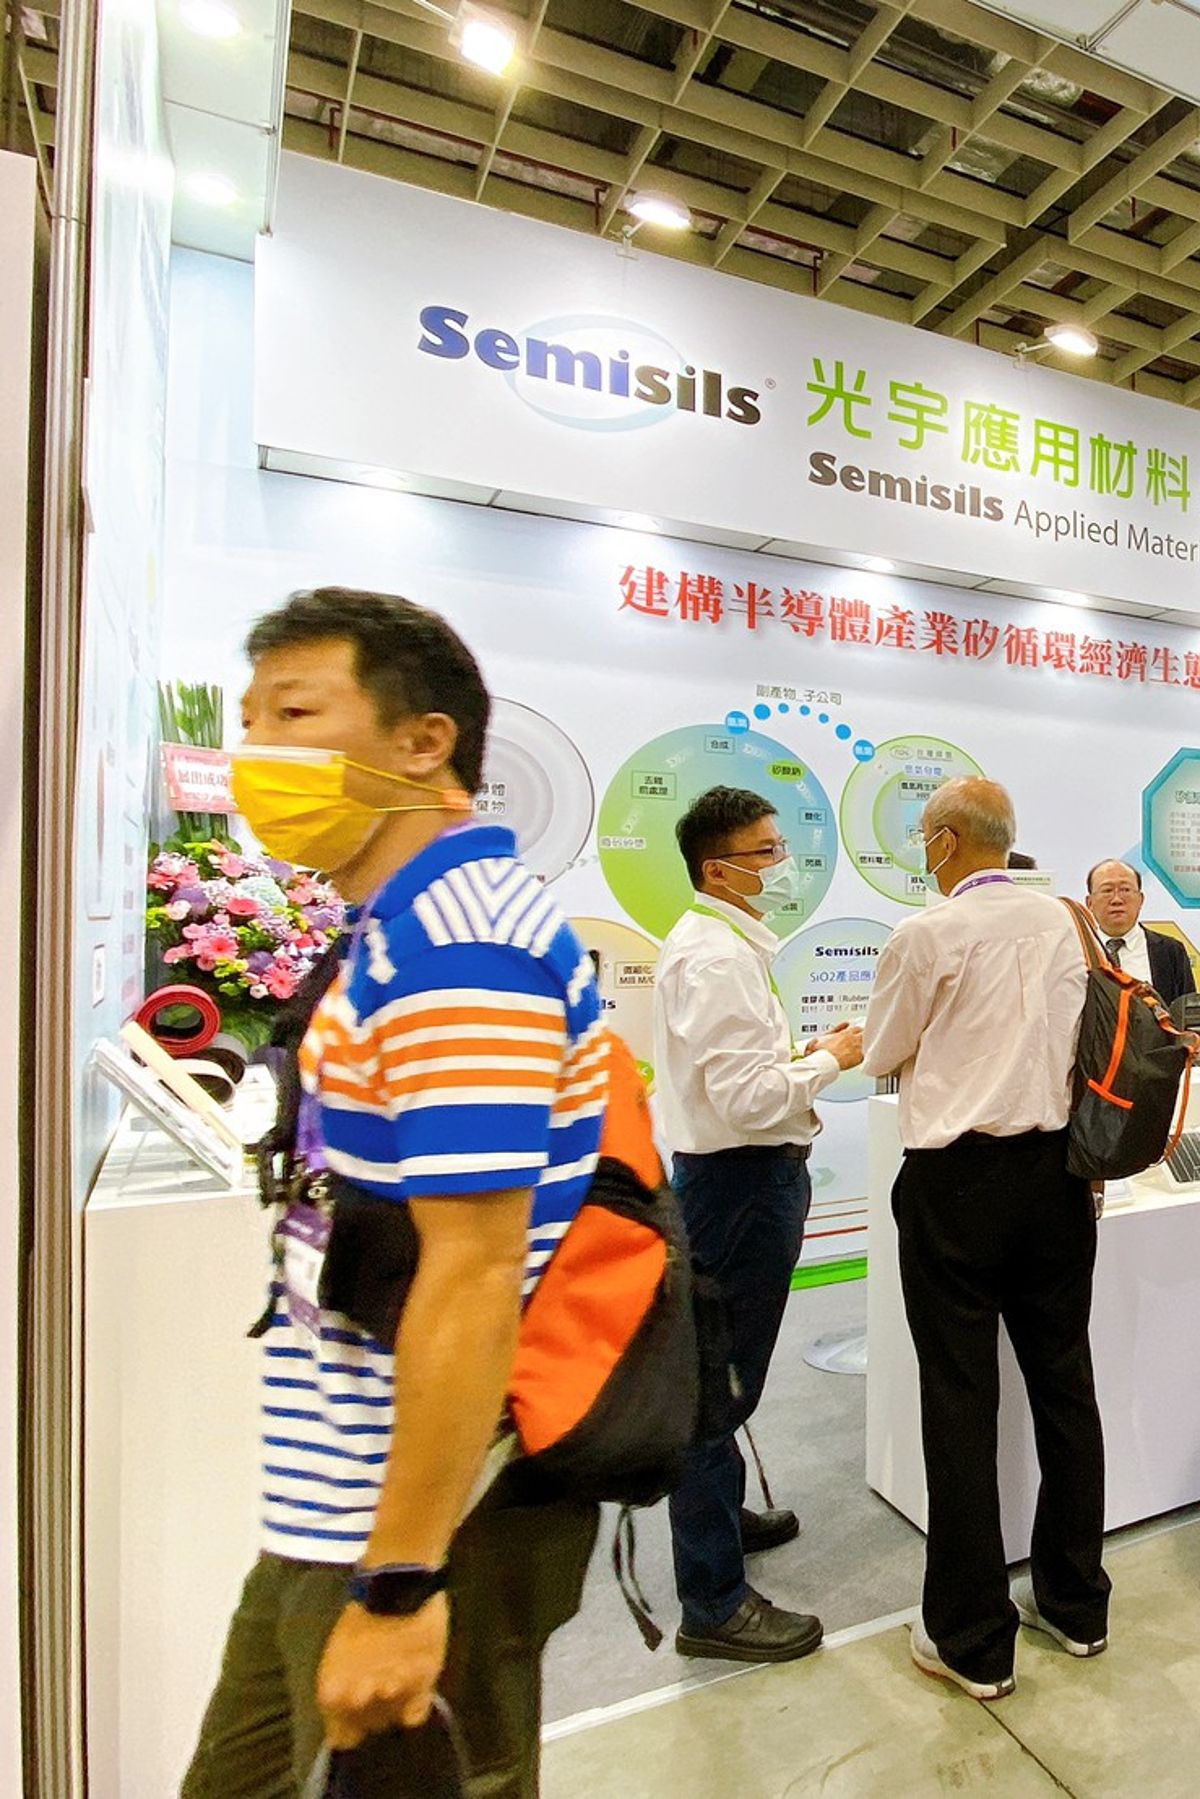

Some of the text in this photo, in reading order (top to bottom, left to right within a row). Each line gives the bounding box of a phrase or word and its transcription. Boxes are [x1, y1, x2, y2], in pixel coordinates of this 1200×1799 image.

[417, 305, 762, 425] Semisils
[806, 357, 1191, 512] 光宇應用材料
[808, 451, 1004, 521] Semisils
[1014, 499, 1120, 547] Applied
[810, 969, 876, 983] SiO2產品應
[815, 945, 880, 957] Semisils
